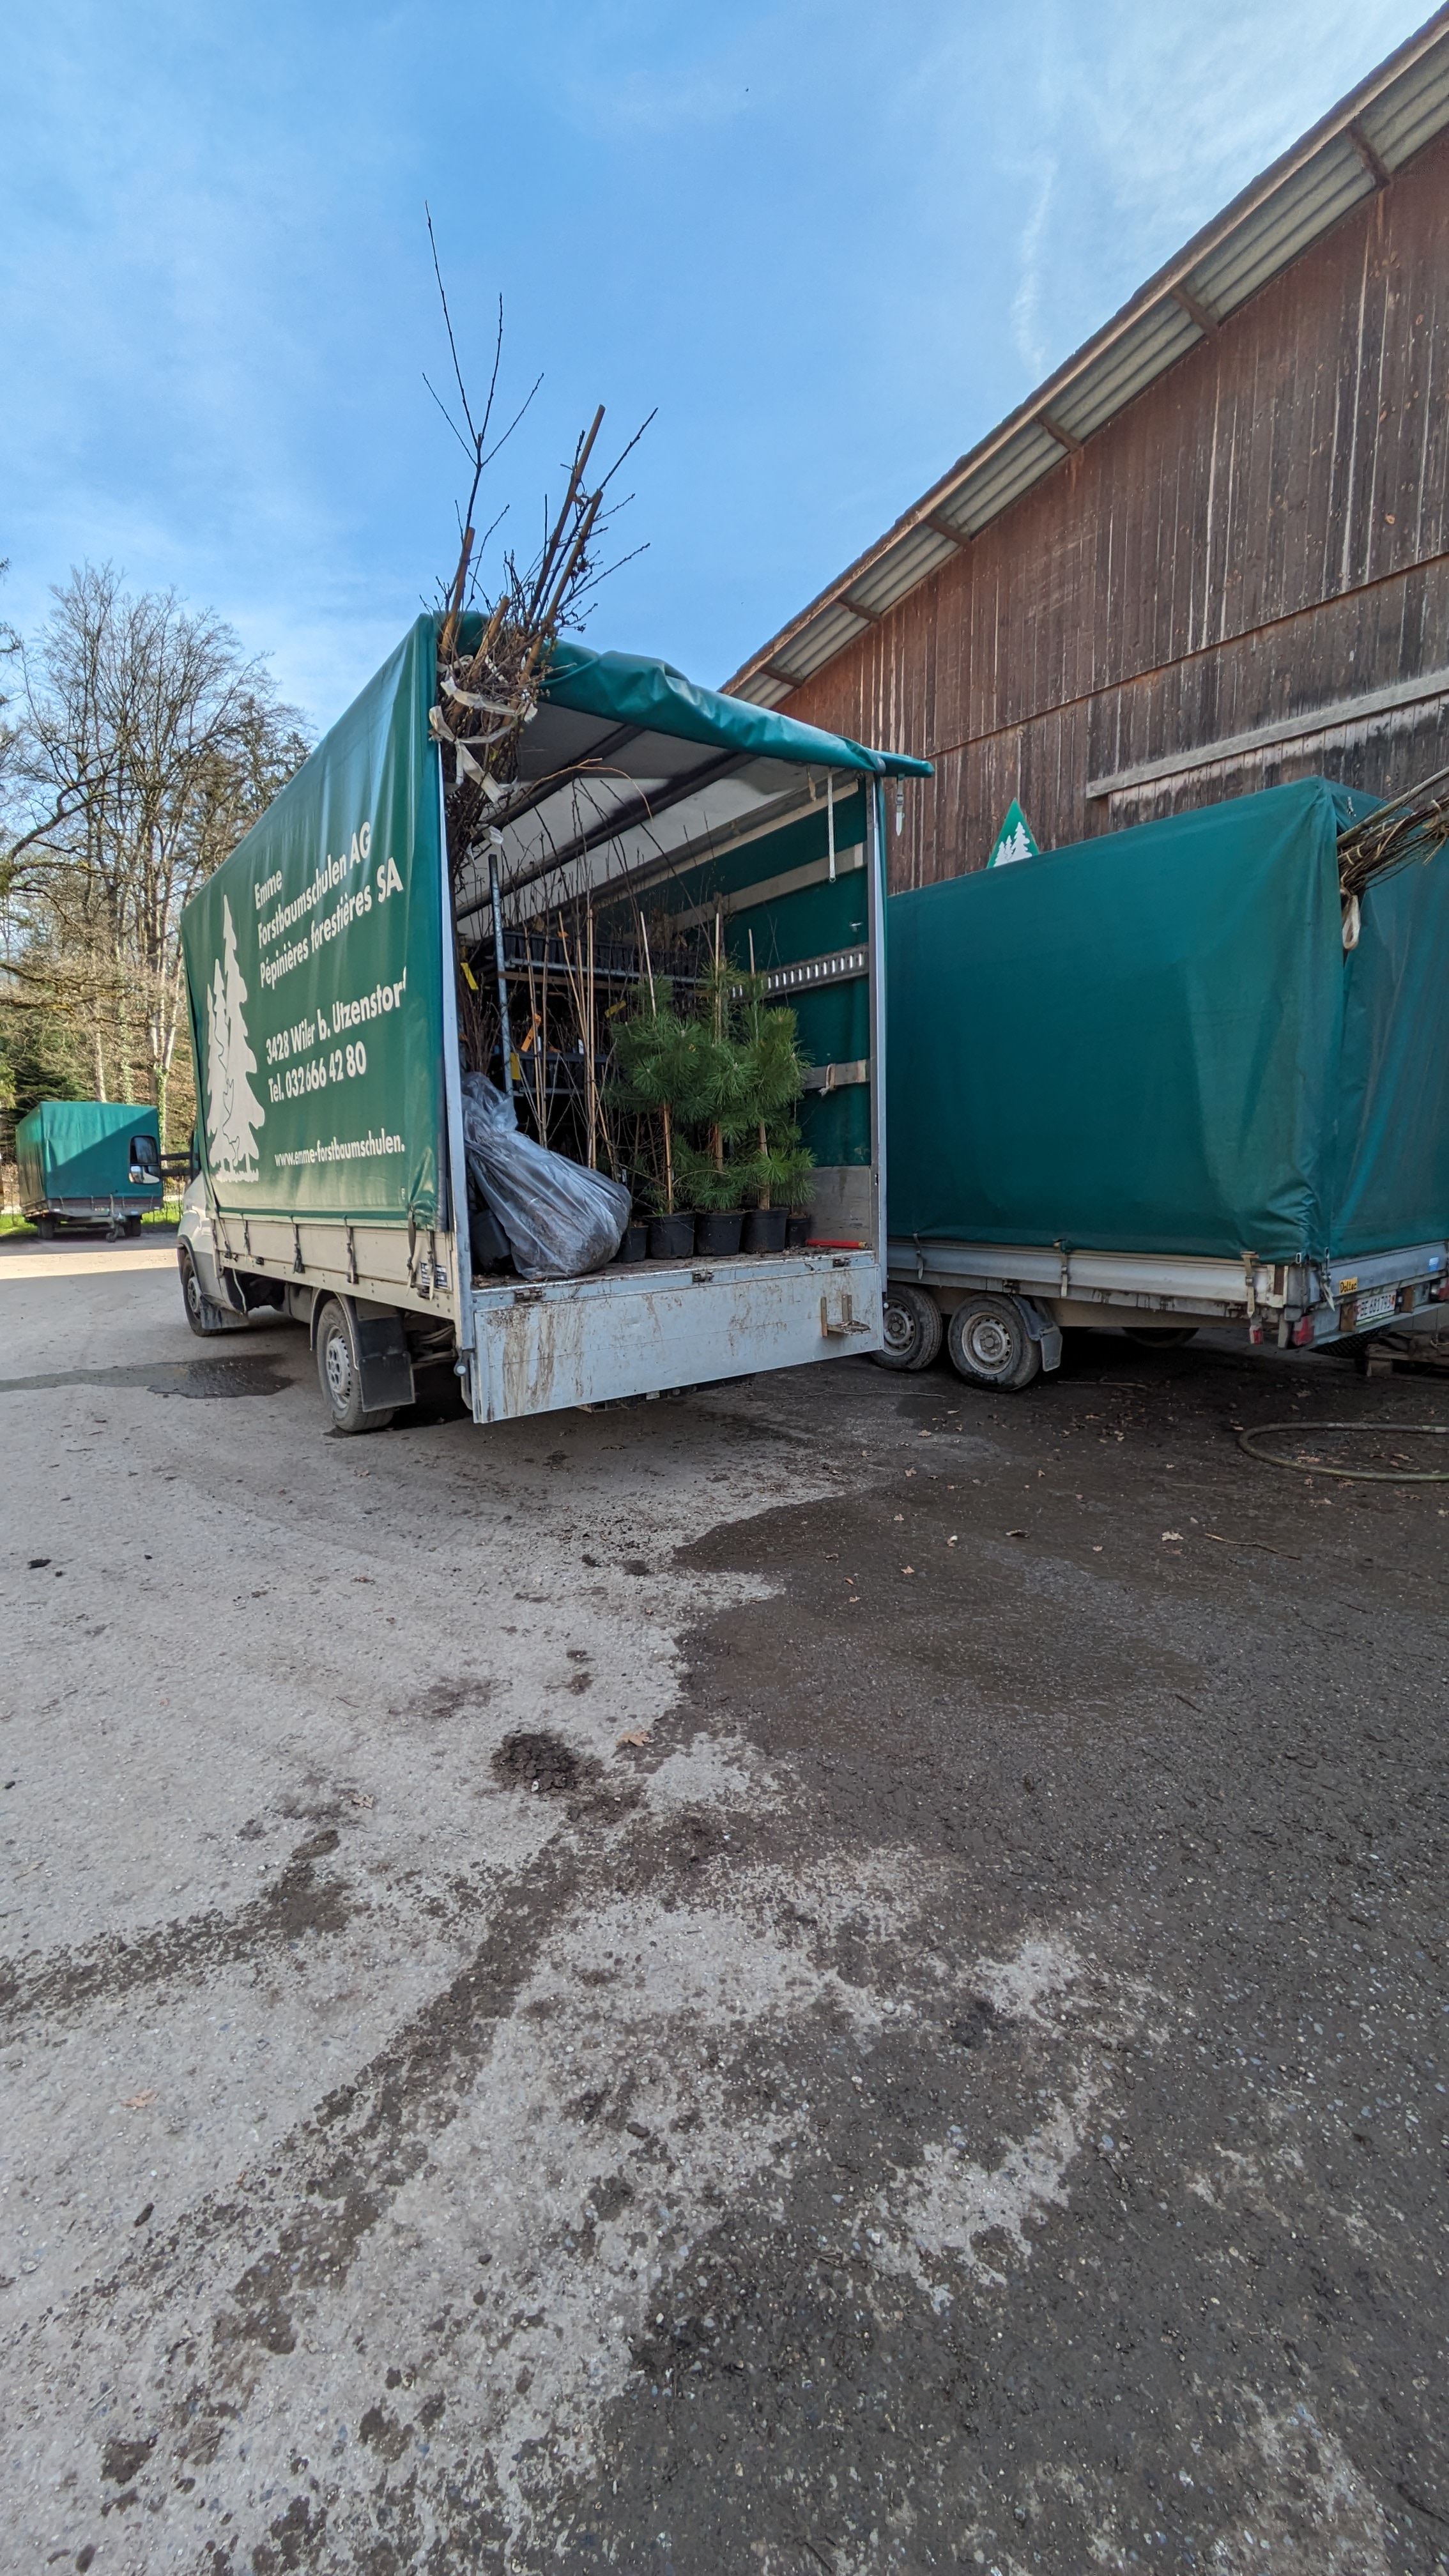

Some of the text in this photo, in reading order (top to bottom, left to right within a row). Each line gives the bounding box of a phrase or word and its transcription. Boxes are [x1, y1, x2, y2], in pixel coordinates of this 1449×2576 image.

[254, 870, 282, 910] Emme
[257, 821, 371, 949] Forstbaumschulen AG
[260, 857, 404, 990] Pépinières forestières SA
[266, 1030, 289, 1066] 3428
[290, 1018, 315, 1054] Wiler
[317, 1008, 331, 1041] b.
[268, 1040, 367, 1103] Tel. 032 666 42 80
